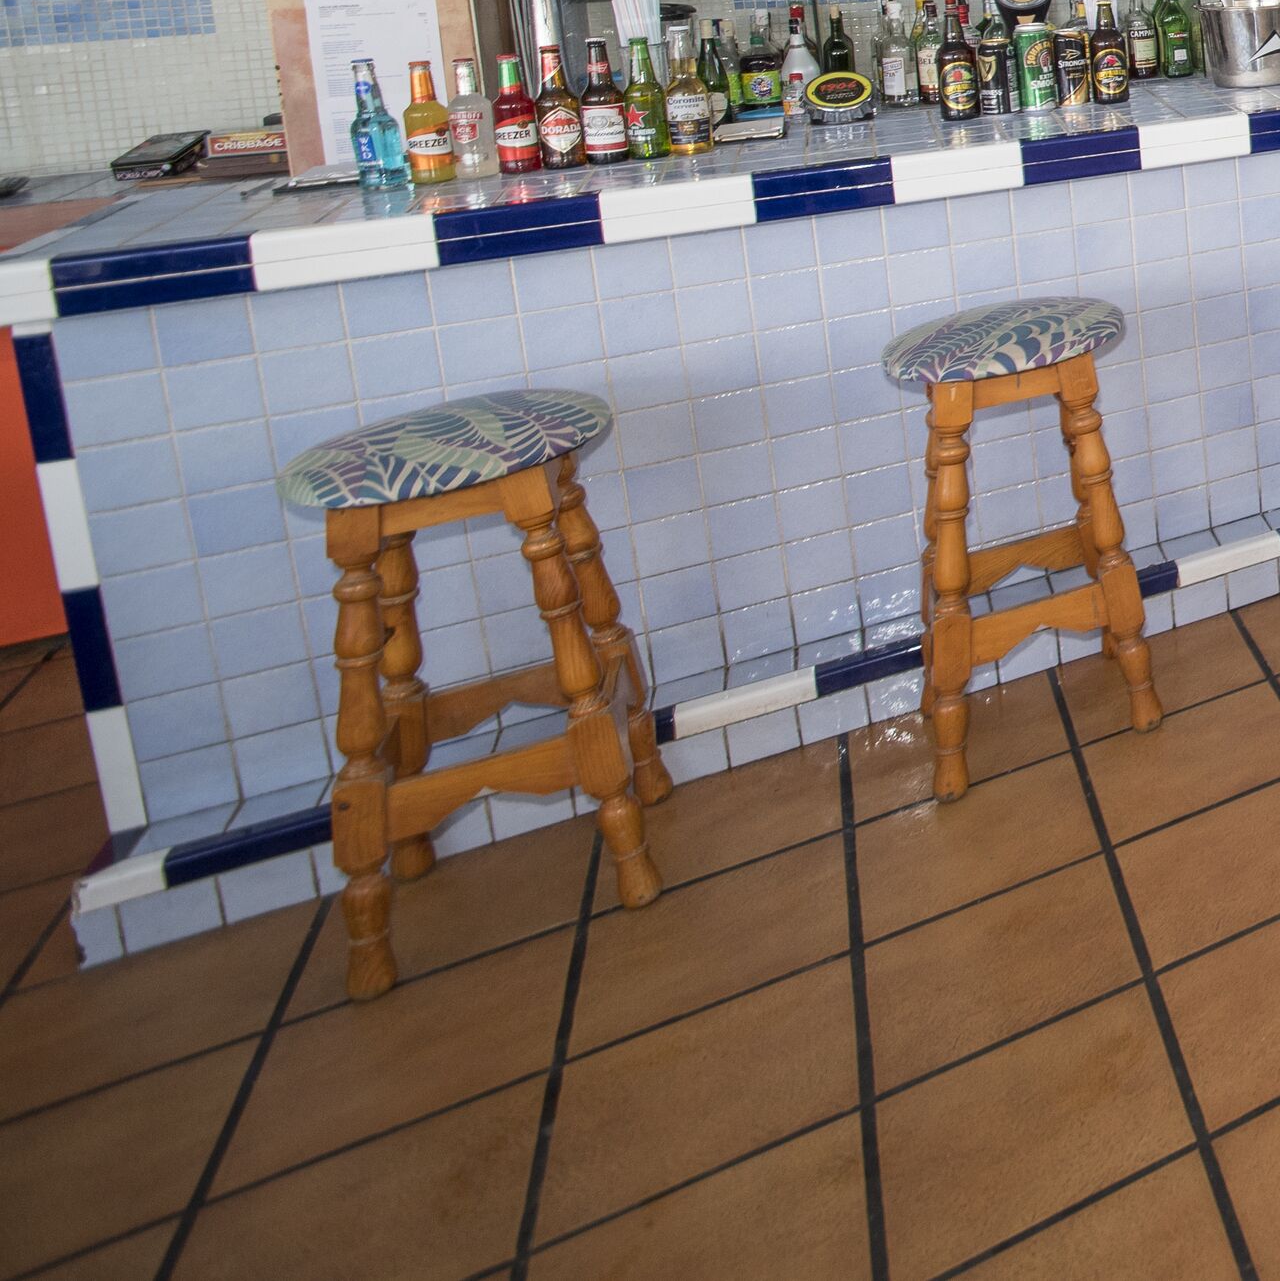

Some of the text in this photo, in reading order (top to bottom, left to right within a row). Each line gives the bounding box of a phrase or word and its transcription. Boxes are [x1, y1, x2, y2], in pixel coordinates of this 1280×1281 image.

[820, 79, 858, 93] 1906
[667, 95, 705, 106] Coronita
[541, 124, 582, 136] DORADA
[213, 137, 285, 152] CRIBBAGE
[408, 136, 449, 149] BREEZER
